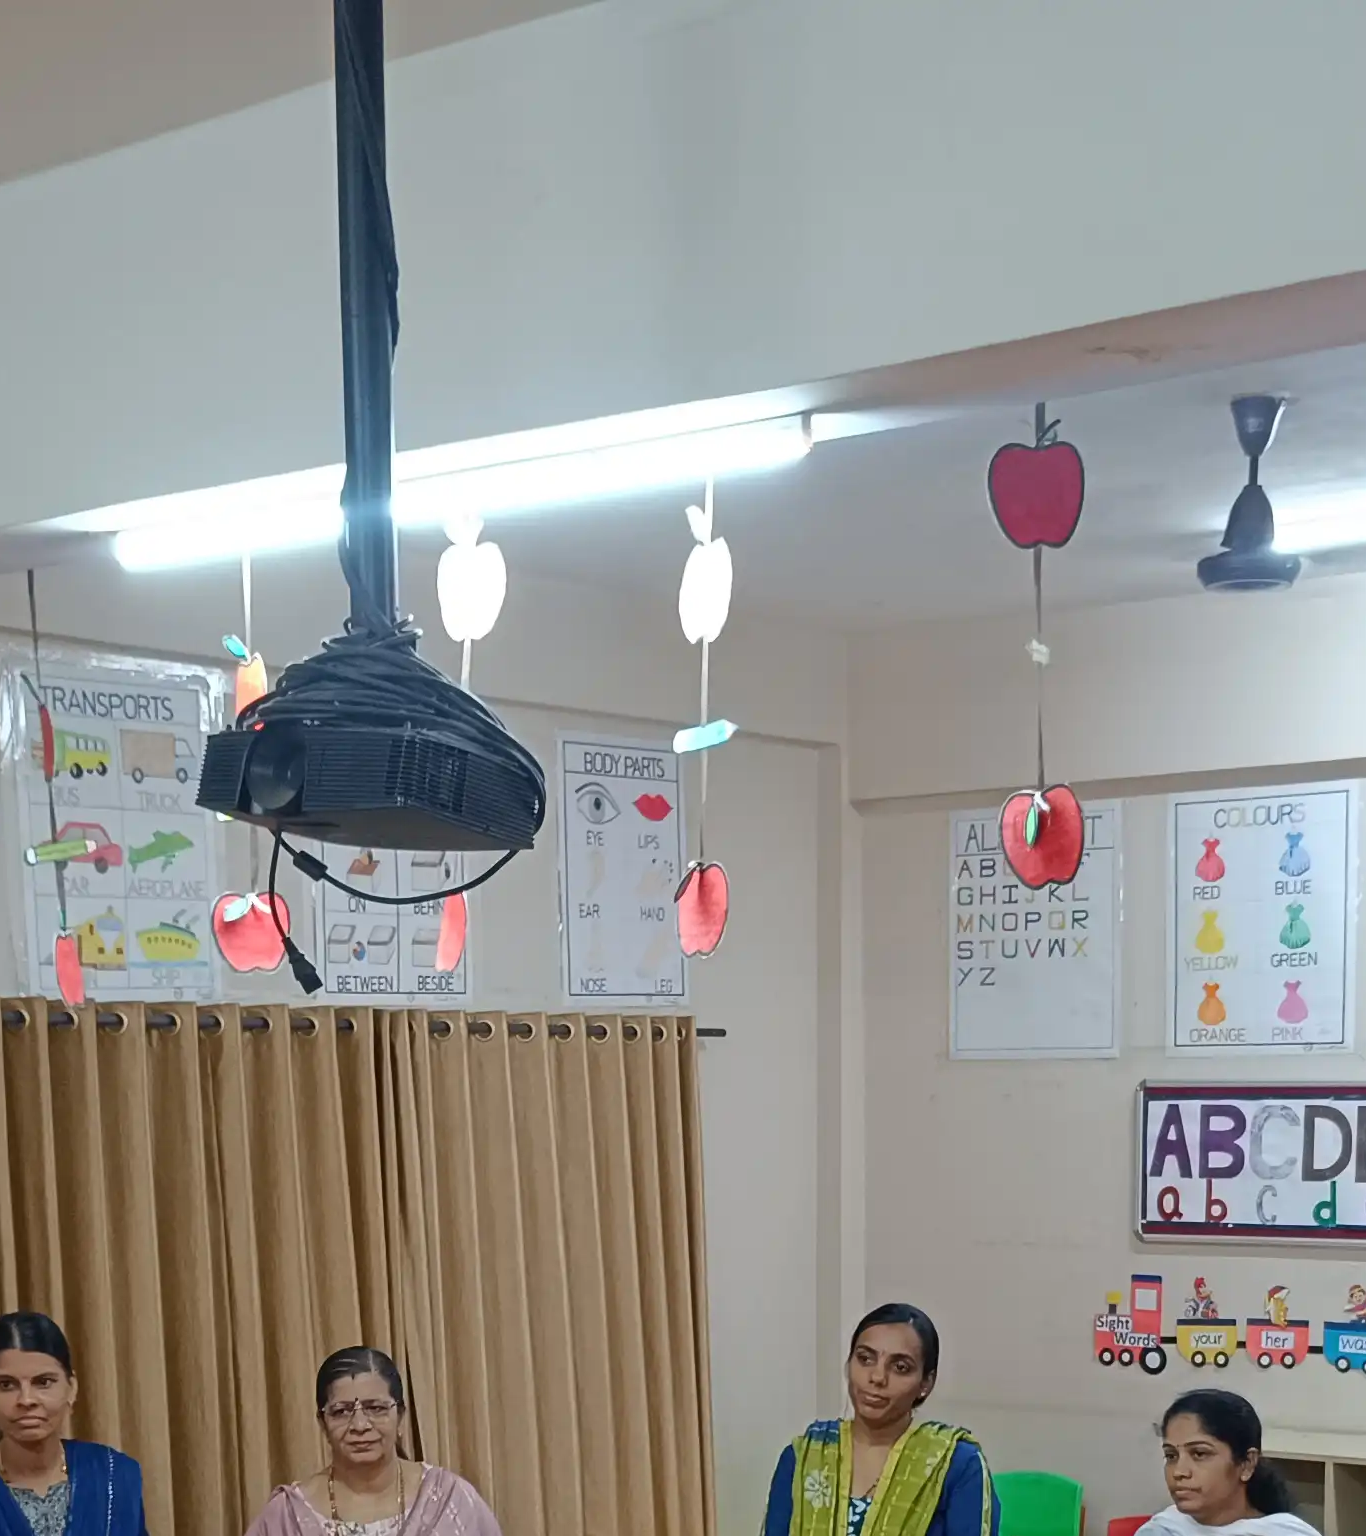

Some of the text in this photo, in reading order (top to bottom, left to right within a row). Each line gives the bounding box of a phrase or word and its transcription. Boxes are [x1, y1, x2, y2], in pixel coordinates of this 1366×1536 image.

[39, 685, 174, 721] TRANSPORTS
[583, 751, 665, 778] BODY PARTS
[136, 790, 184, 813] TRUCK
[1214, 803, 1306, 828] COLOURS
[586, 830, 605, 847] EYE
[637, 833, 660, 850] LIPS
[1192, 885, 1221, 900] RED
[1274, 879, 1312, 895] BLUE
[578, 903, 600, 919] EAR
[639, 905, 666, 922] HAND
[1184, 954, 1239, 972] YELLOW
[1270, 951, 1318, 968] GREEN
[337, 975, 394, 992] BETWEEN
[417, 975, 455, 992] BESIDE
[580, 977, 607, 993] NOSE
[654, 979, 673, 994] LEG
[1189, 1027, 1247, 1043] ORANGE
[1271, 1026, 1304, 1042] PINK
[1157, 1186, 1183, 1221] a
[1205, 1178, 1228, 1222] b
[1256, 1184, 1278, 1225] c
[1312, 1180, 1336, 1228] d
[1095, 1315, 1131, 1332] Sight
[1114, 1333, 1158, 1348] Words
[1193, 1332, 1223, 1347] your
[1264, 1333, 1289, 1348] her
